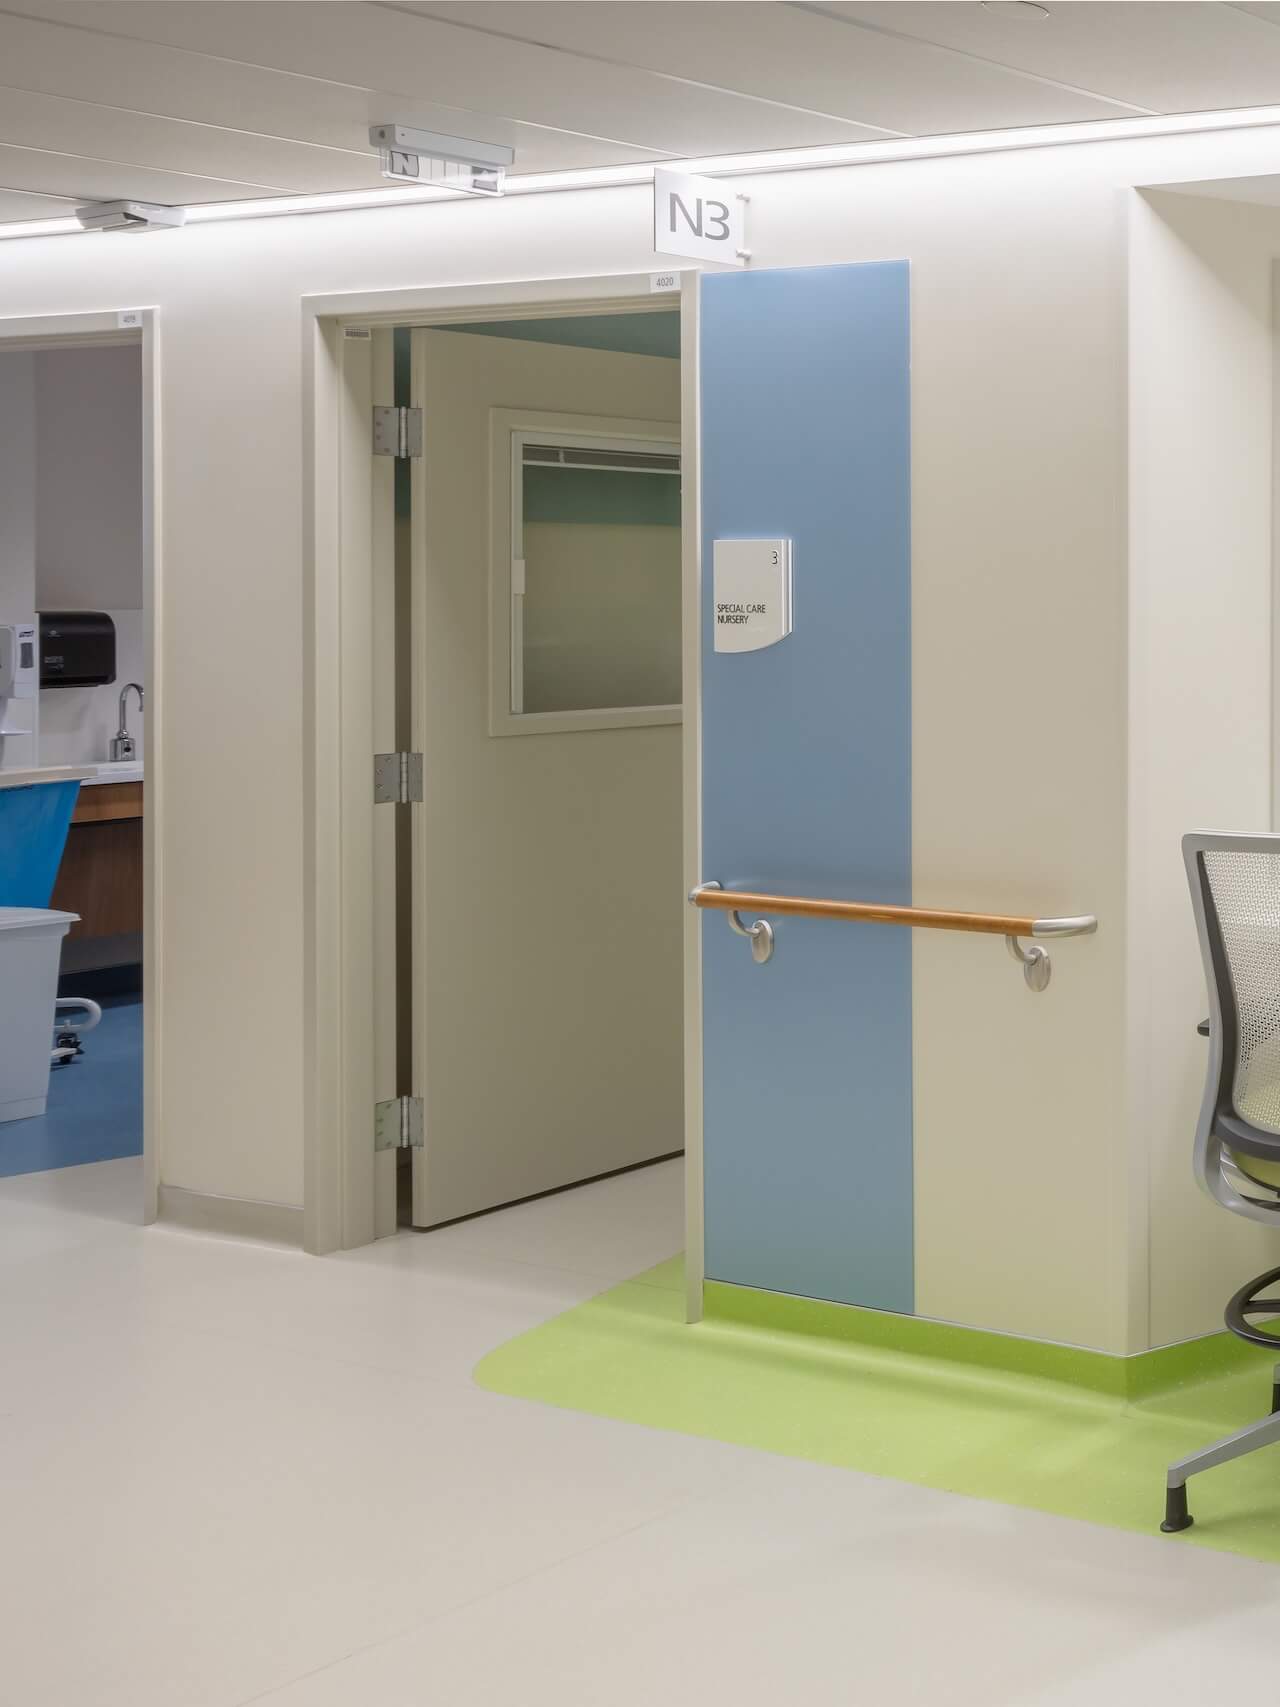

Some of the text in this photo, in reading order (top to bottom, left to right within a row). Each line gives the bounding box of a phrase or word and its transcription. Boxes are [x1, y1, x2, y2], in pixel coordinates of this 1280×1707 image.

[669, 192, 730, 241] N3
[656, 277, 674, 287] 4020
[771, 551, 778, 565] 3
[717, 604, 766, 613] SPECIAL CARE
[717, 615, 749, 624] NURSERY
